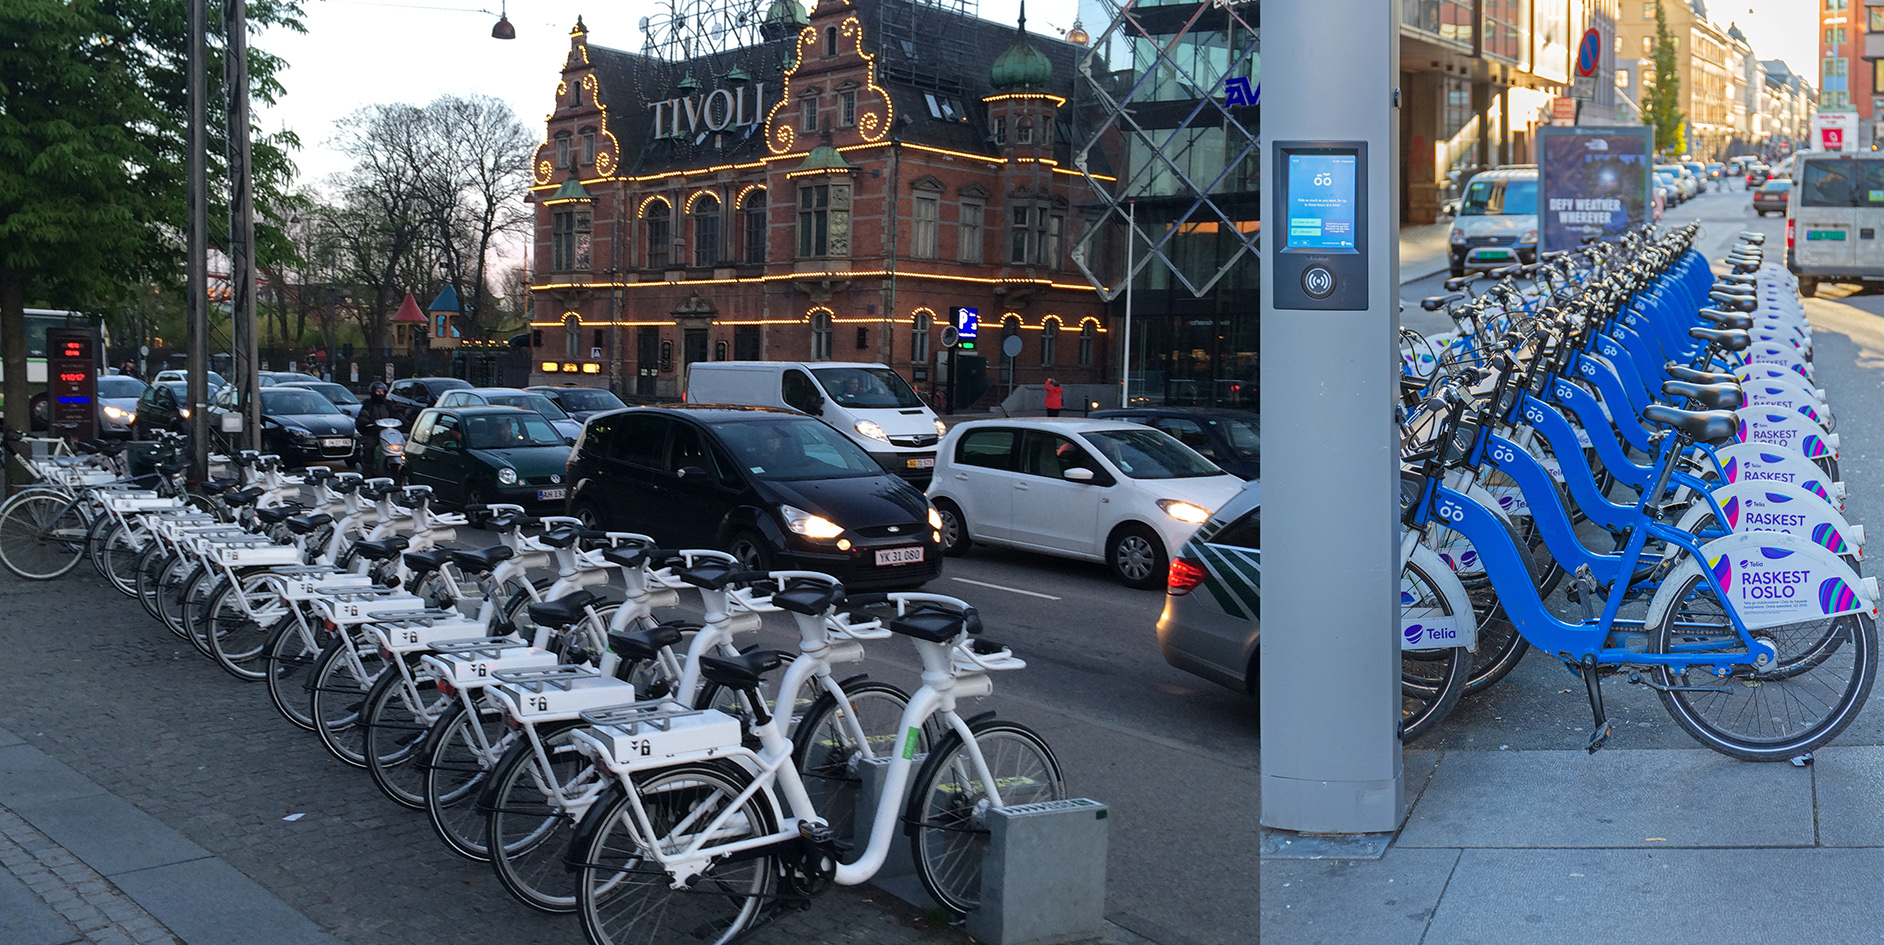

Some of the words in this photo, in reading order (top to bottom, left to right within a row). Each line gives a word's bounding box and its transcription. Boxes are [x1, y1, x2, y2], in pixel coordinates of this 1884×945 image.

[647, 82, 765, 139] TIVOLI
[1549, 198, 1574, 211] DEFY
[1575, 198, 1621, 211] WEATHER
[1558, 211, 1612, 224] WHEREVER
[959, 311, 968, 329] P
[1753, 430, 1798, 439] RASKEST
[1549, 468, 1563, 476] Tel
[1744, 471, 1796, 483] RASKEST
[1746, 512, 1806, 526] RASKEST
[879, 552, 891, 562] YK
[892, 551, 902, 561] 31
[904, 549, 920, 560] 080
[1742, 570, 1811, 585] RASKEST
[1742, 586, 1746, 599] I
[1751, 585, 1795, 599] OSLO
[1426, 627, 1456, 640] Telia
